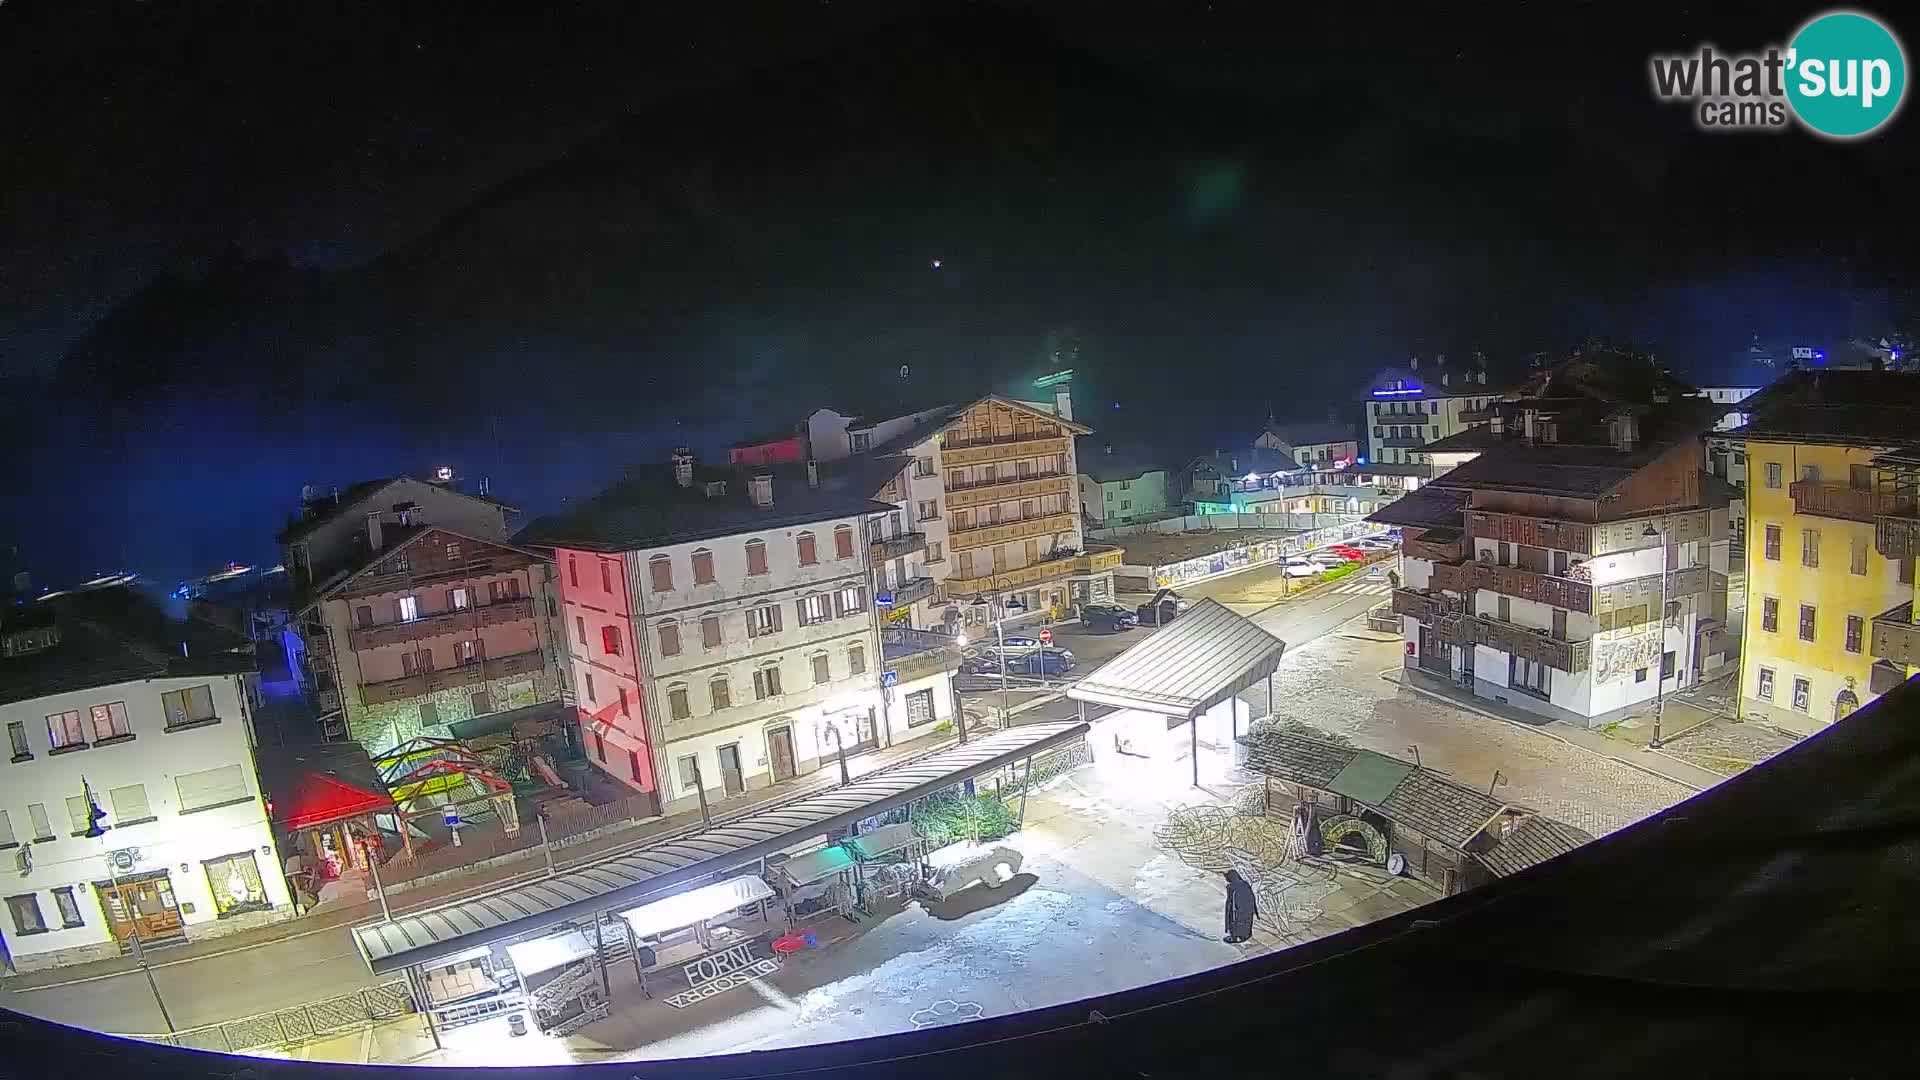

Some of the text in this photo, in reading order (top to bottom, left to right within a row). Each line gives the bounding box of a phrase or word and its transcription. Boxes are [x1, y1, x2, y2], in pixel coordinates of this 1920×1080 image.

[665, 960, 778, 1008] DI SOPRA
[684, 942, 757, 987] FORNI
